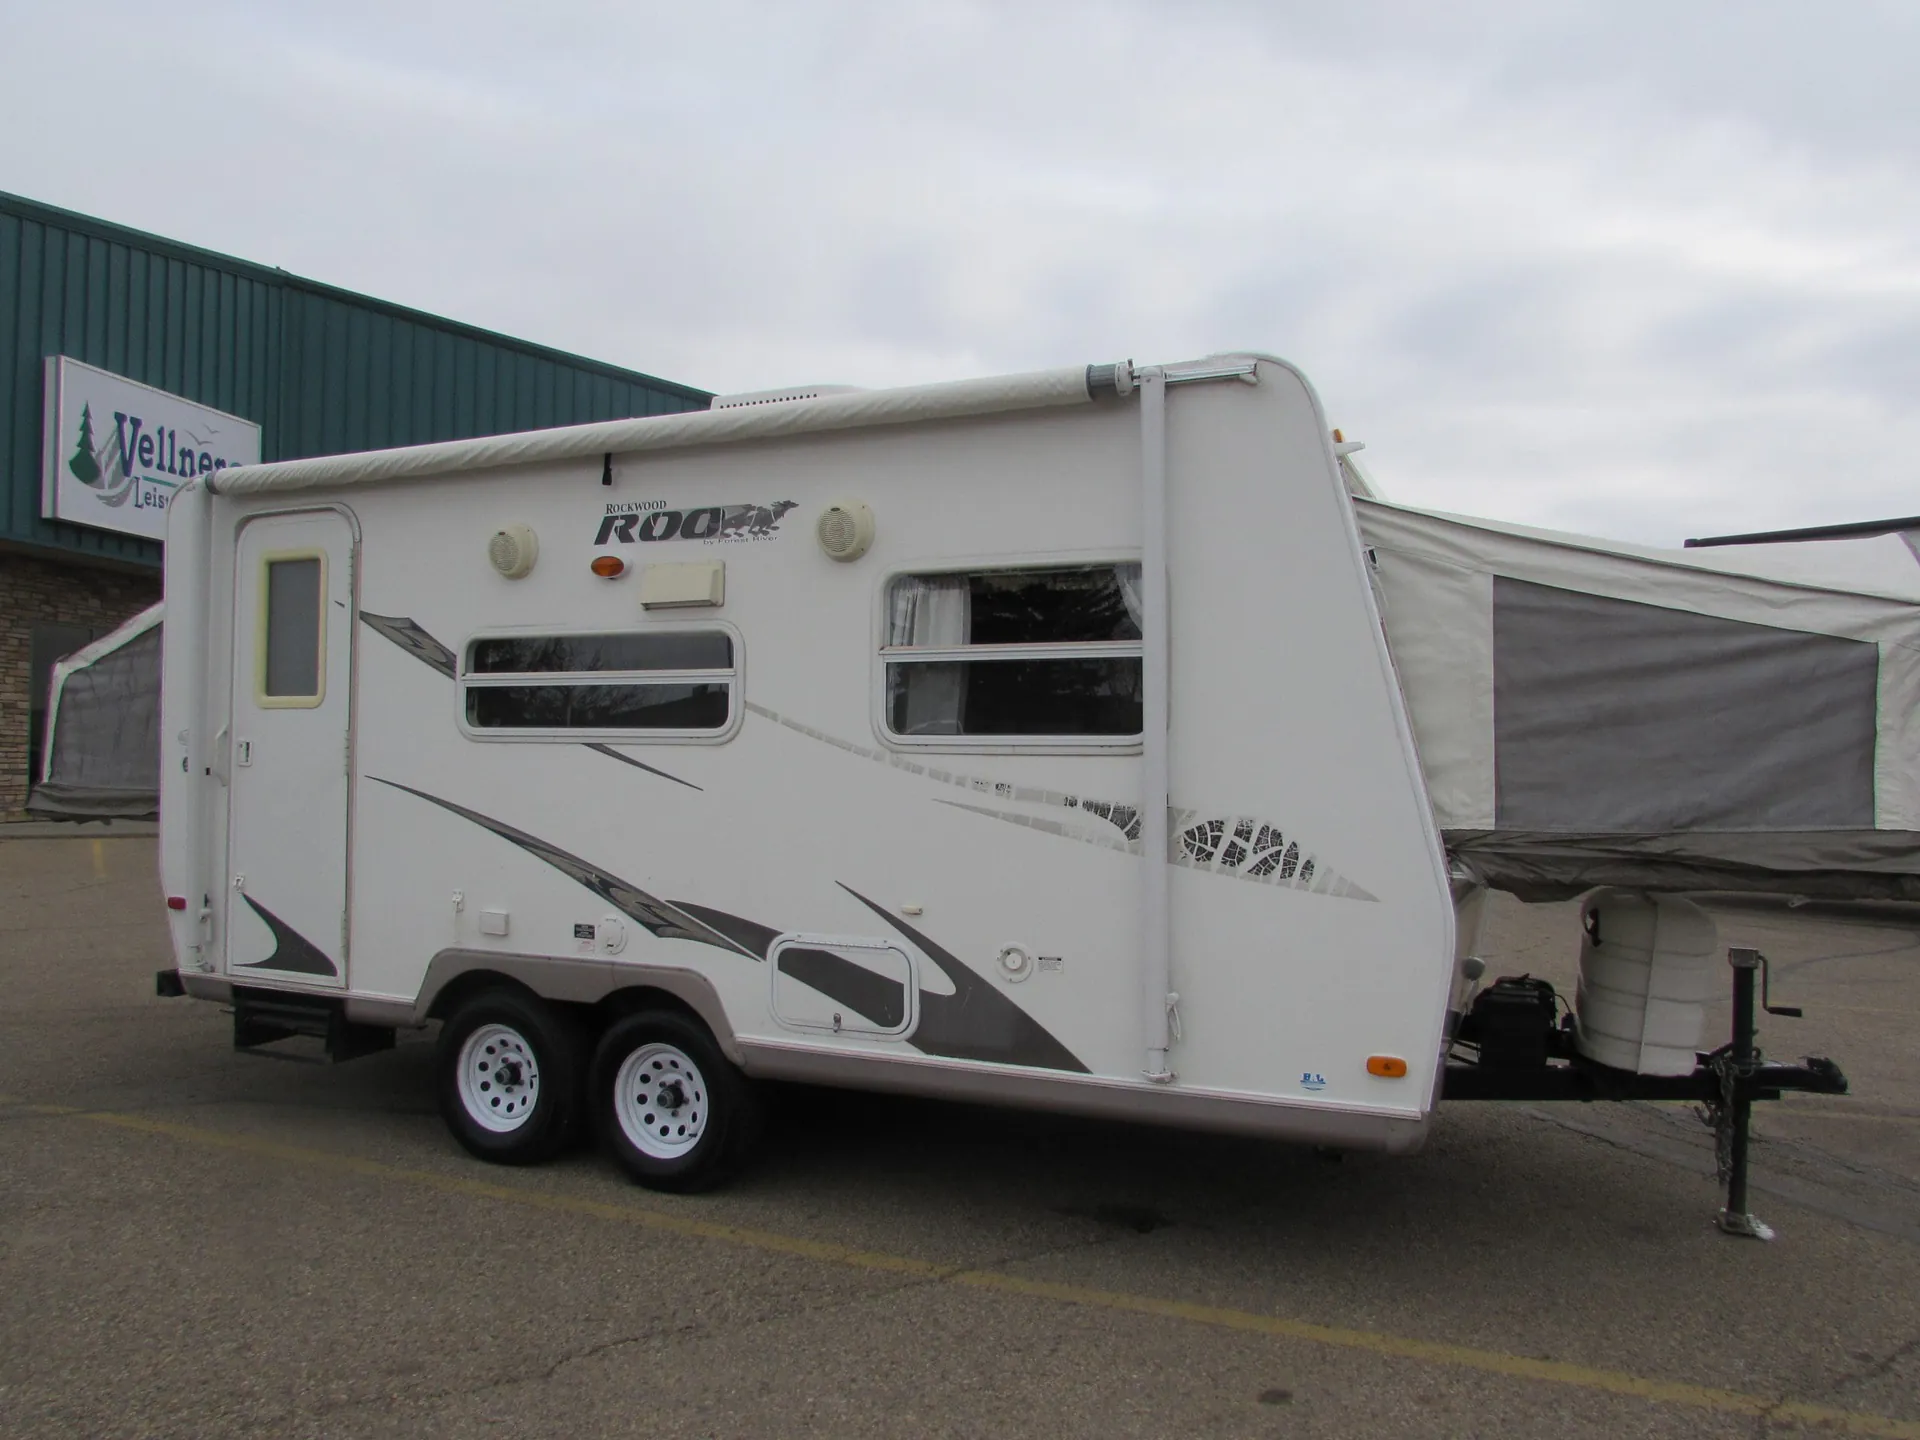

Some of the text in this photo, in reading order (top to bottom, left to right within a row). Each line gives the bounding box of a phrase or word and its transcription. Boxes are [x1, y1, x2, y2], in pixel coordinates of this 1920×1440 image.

[114, 411, 243, 478] Vellner
[134, 477, 169, 509] Leis
[606, 500, 667, 514] ROCKWOOD
[594, 507, 725, 545] ROO
